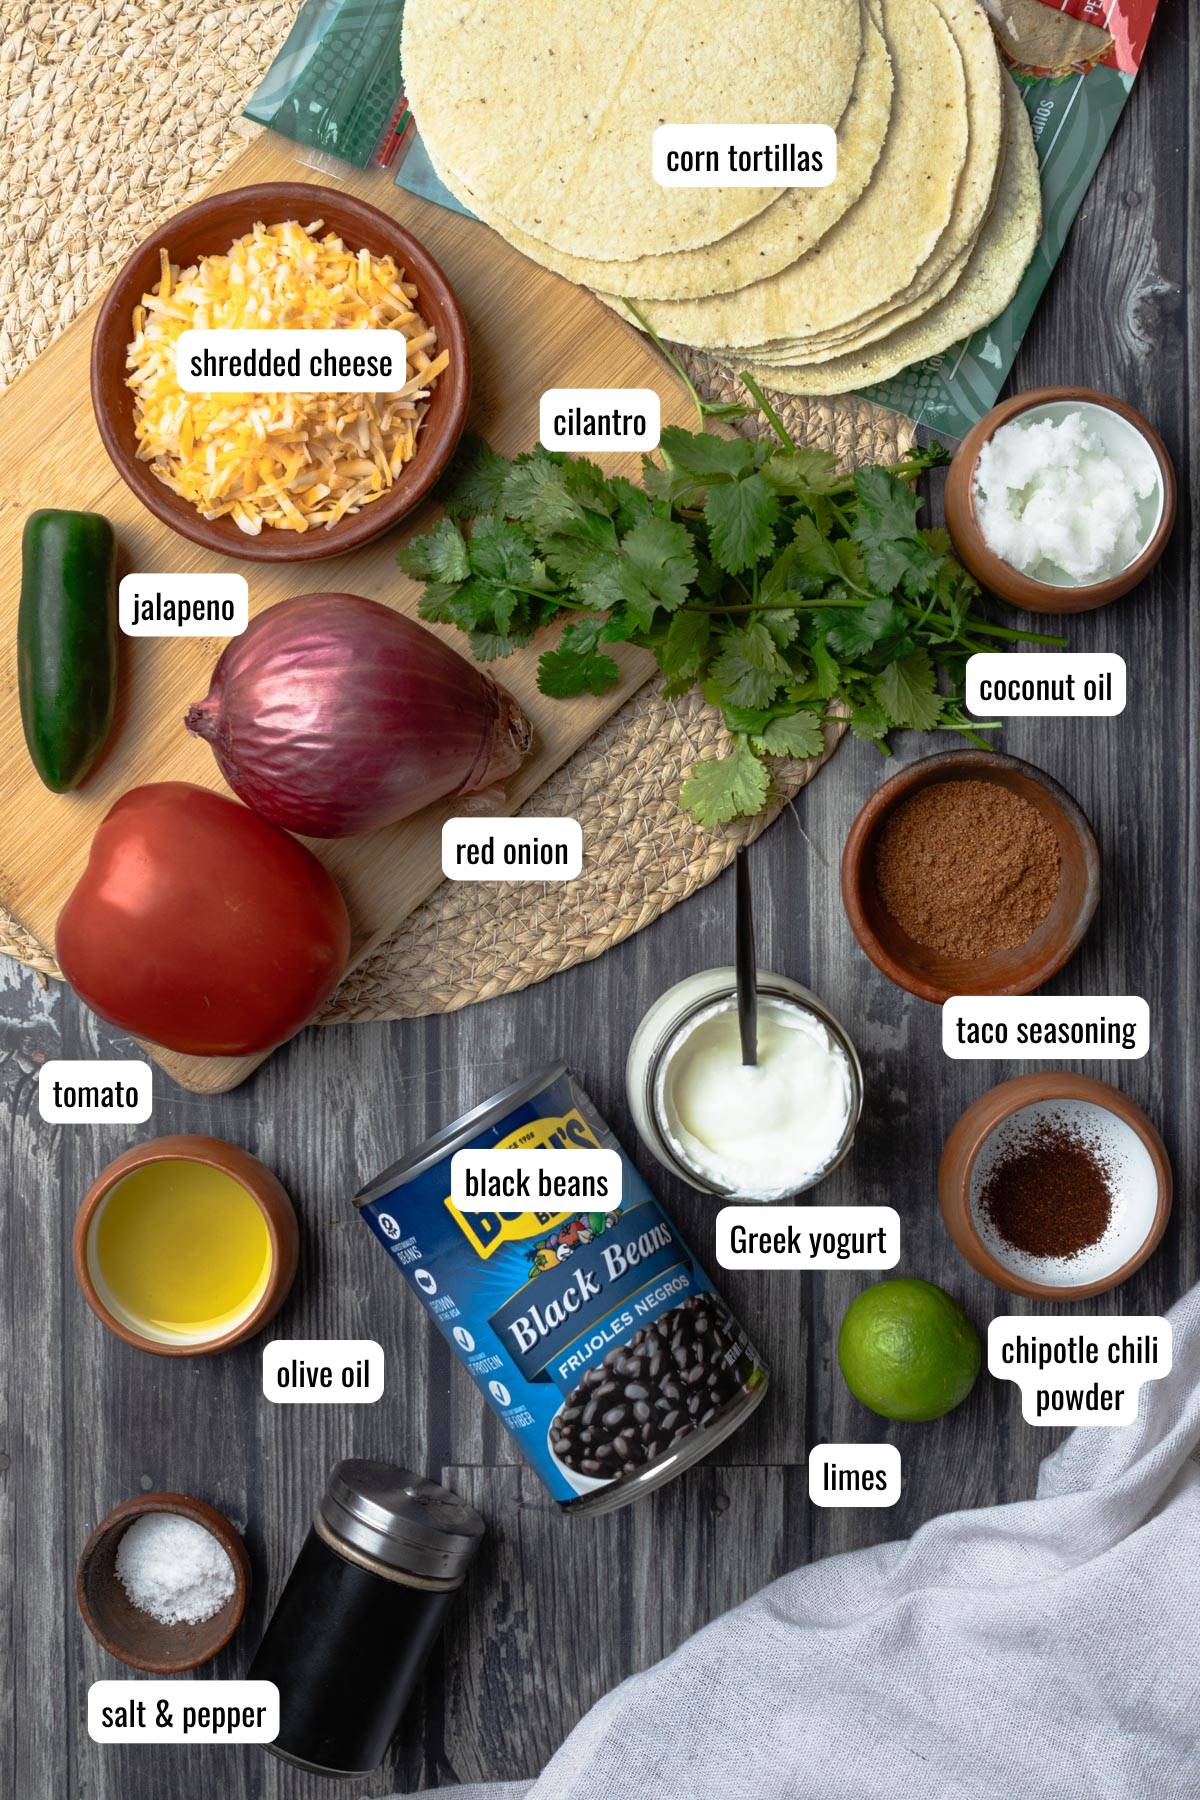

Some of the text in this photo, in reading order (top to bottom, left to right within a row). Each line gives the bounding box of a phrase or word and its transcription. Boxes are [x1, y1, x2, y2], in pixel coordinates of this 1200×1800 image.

[518, 1131, 535, 1144] 1908
[397, 1245, 422, 1265] BEANS
[507, 1222, 672, 1354] Black Beans
[558, 1274, 690, 1379] FRIJOLES NEGROS
